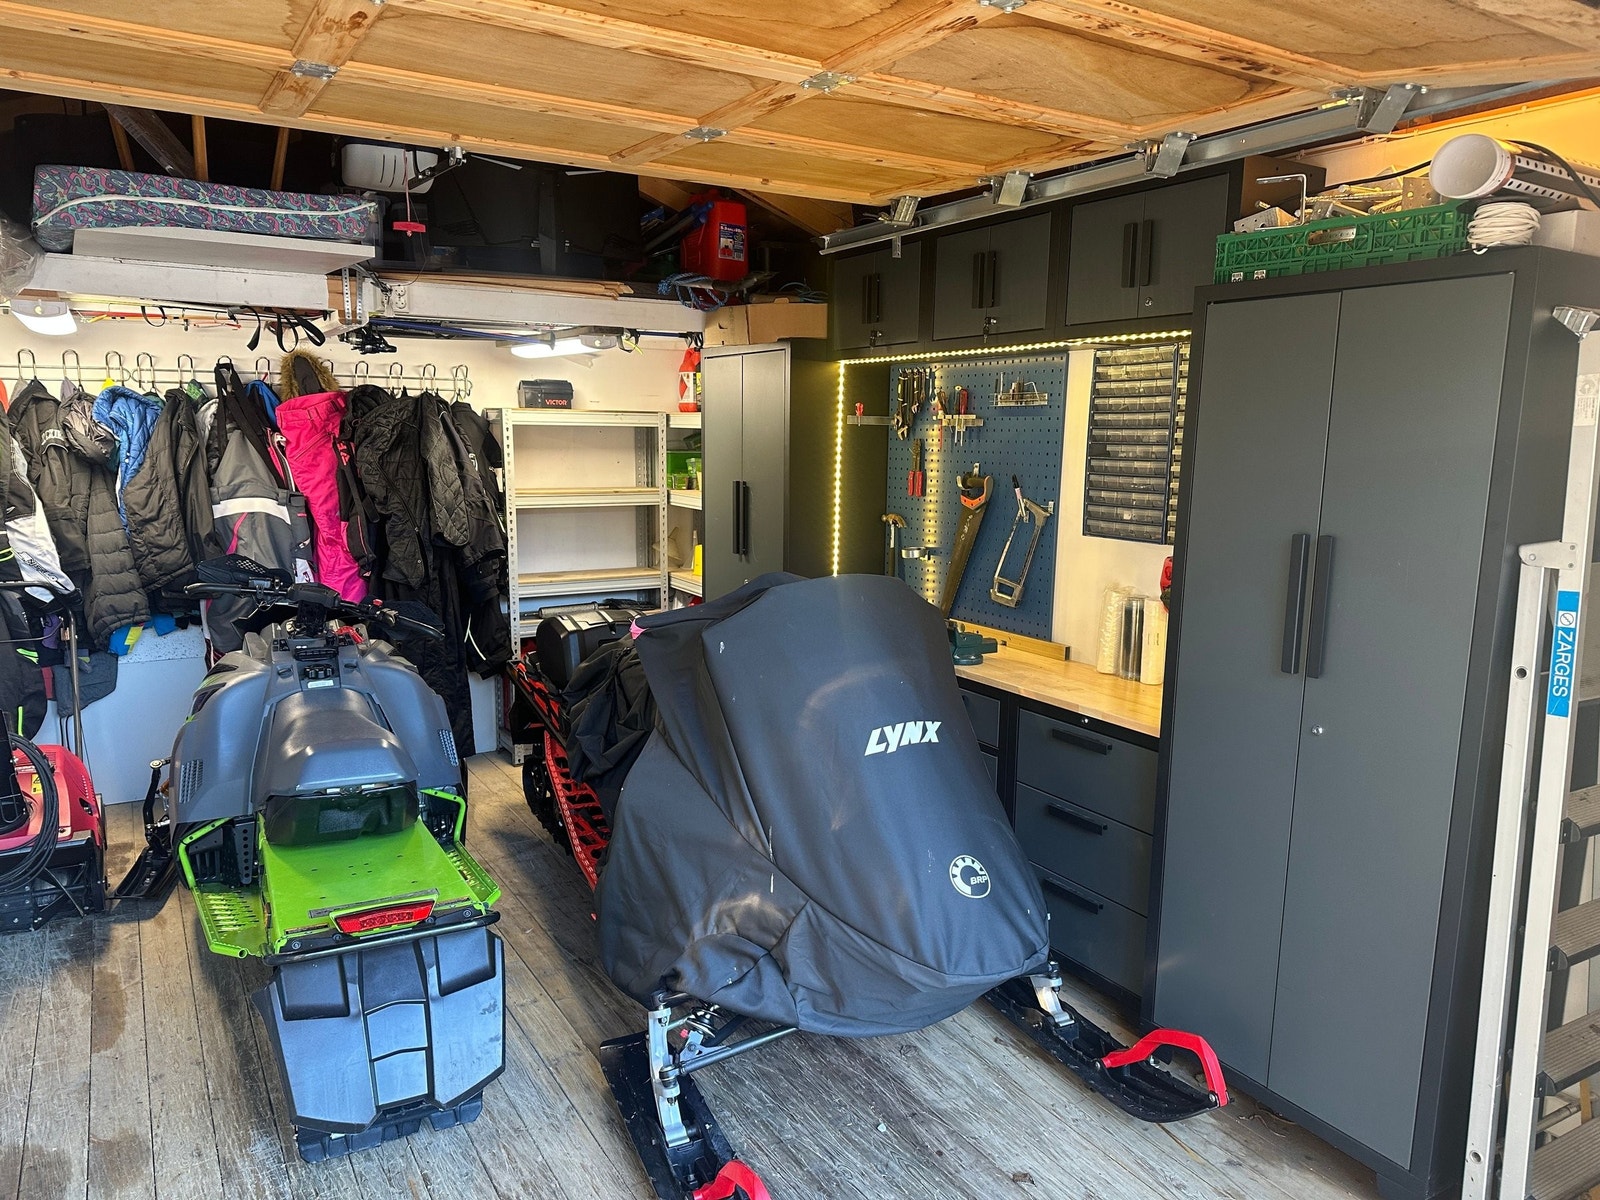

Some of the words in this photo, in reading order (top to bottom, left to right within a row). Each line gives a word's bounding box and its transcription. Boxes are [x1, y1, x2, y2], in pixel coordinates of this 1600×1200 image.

[1552, 630, 1574, 698] ZARGES
[864, 721, 942, 756] LYNX
[970, 875, 988, 885] BRP
